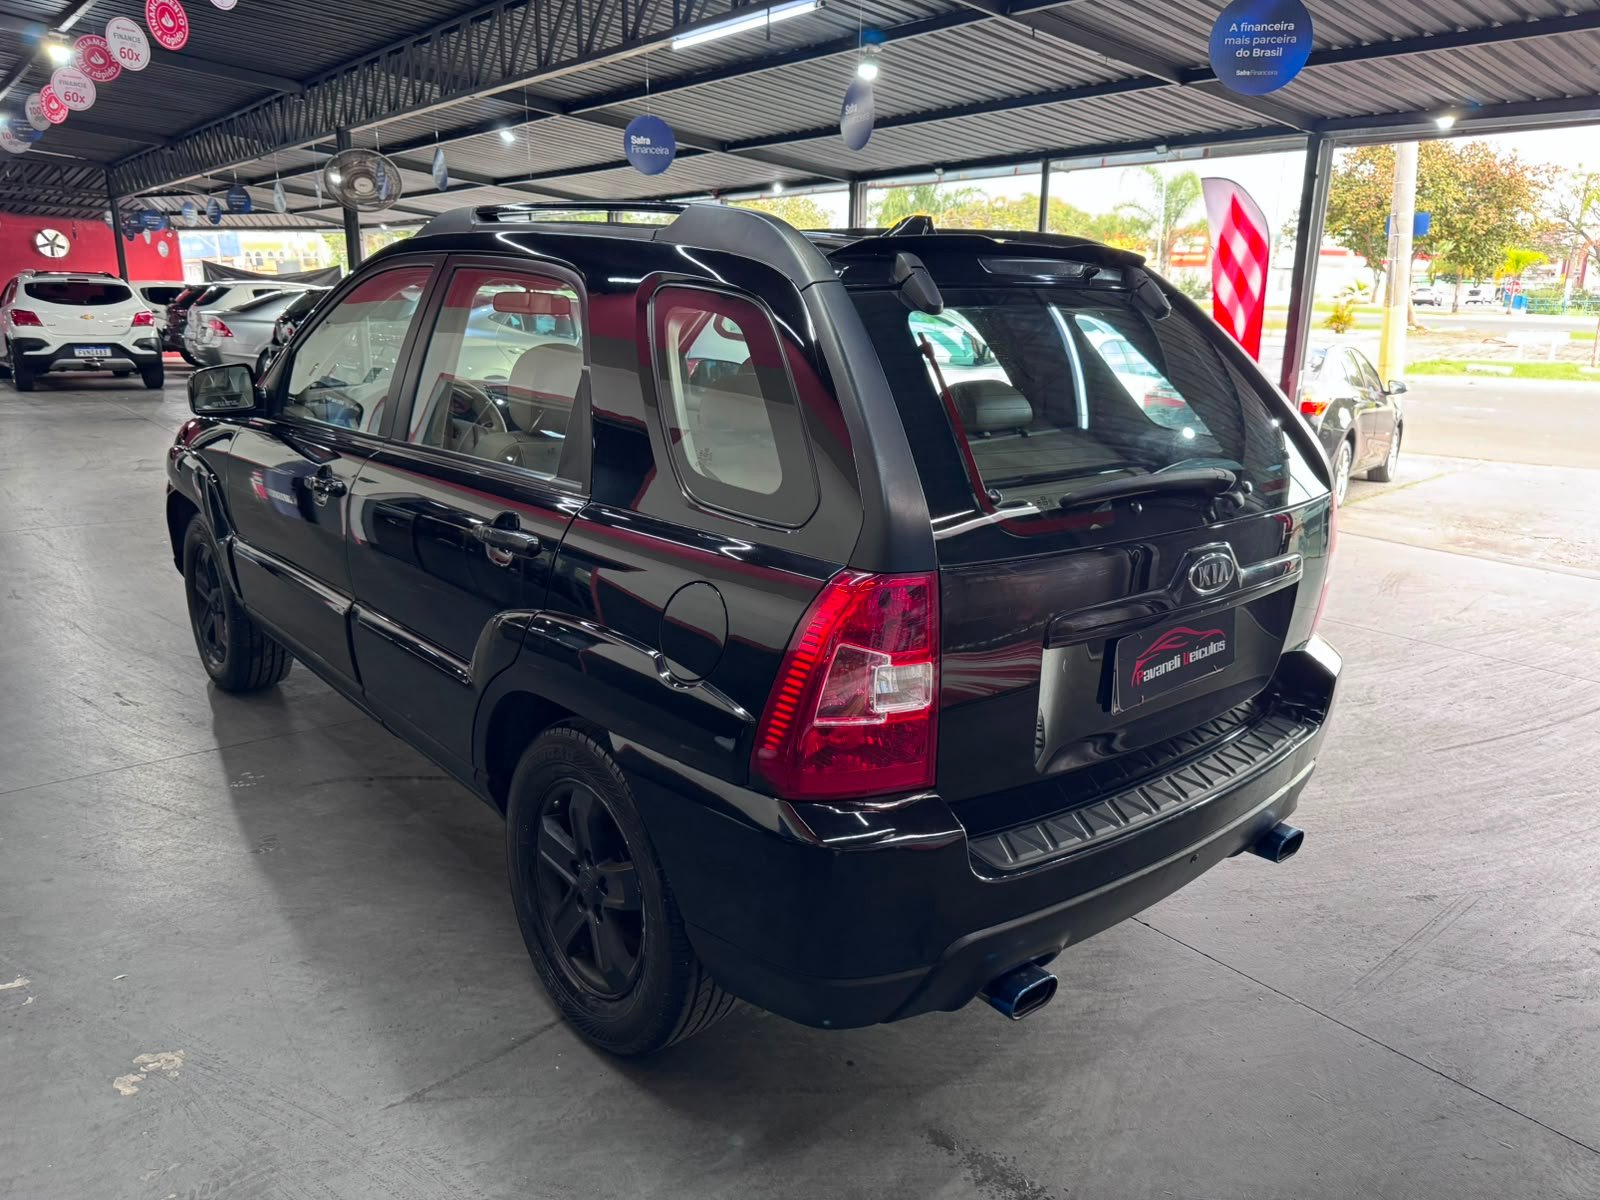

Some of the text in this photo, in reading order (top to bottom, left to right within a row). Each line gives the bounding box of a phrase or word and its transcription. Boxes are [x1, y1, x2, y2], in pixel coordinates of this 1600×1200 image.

[149, 0, 185, 36] FINANCENTO
[1229, 21, 1295, 32] A financeira
[1224, 34, 1297, 46] mais parceira
[119, 46, 141, 62] 60x
[1235, 47, 1283, 57] do Brasil
[91, 66, 117, 80] rápido
[63, 91, 86, 103] 60x
[630, 135, 651, 145] Safra
[631, 145, 670, 155] Financeira
[1199, 561, 1229, 586] KIA
[1135, 654, 1181, 687] Pavaneli
